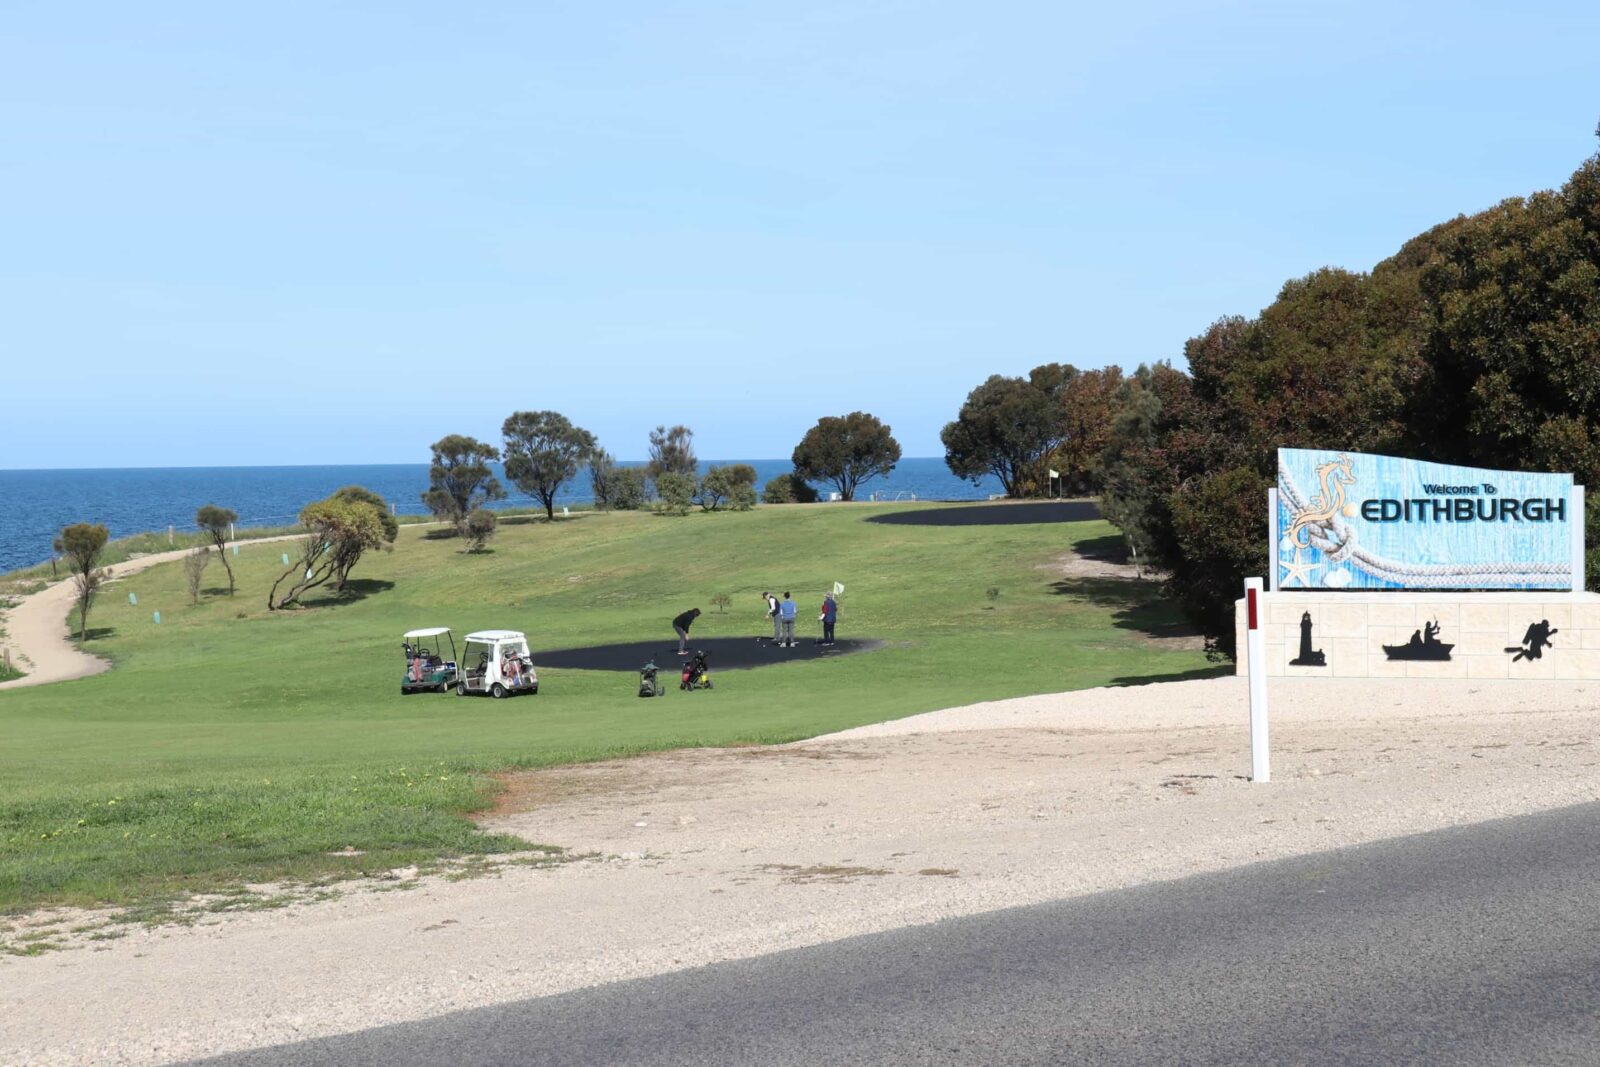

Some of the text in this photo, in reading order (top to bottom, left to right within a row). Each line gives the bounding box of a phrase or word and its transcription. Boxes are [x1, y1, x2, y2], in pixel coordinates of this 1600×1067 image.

[1423, 483, 1497, 495] Welcome To
[1361, 498, 1566, 522] EDITHBURGH
